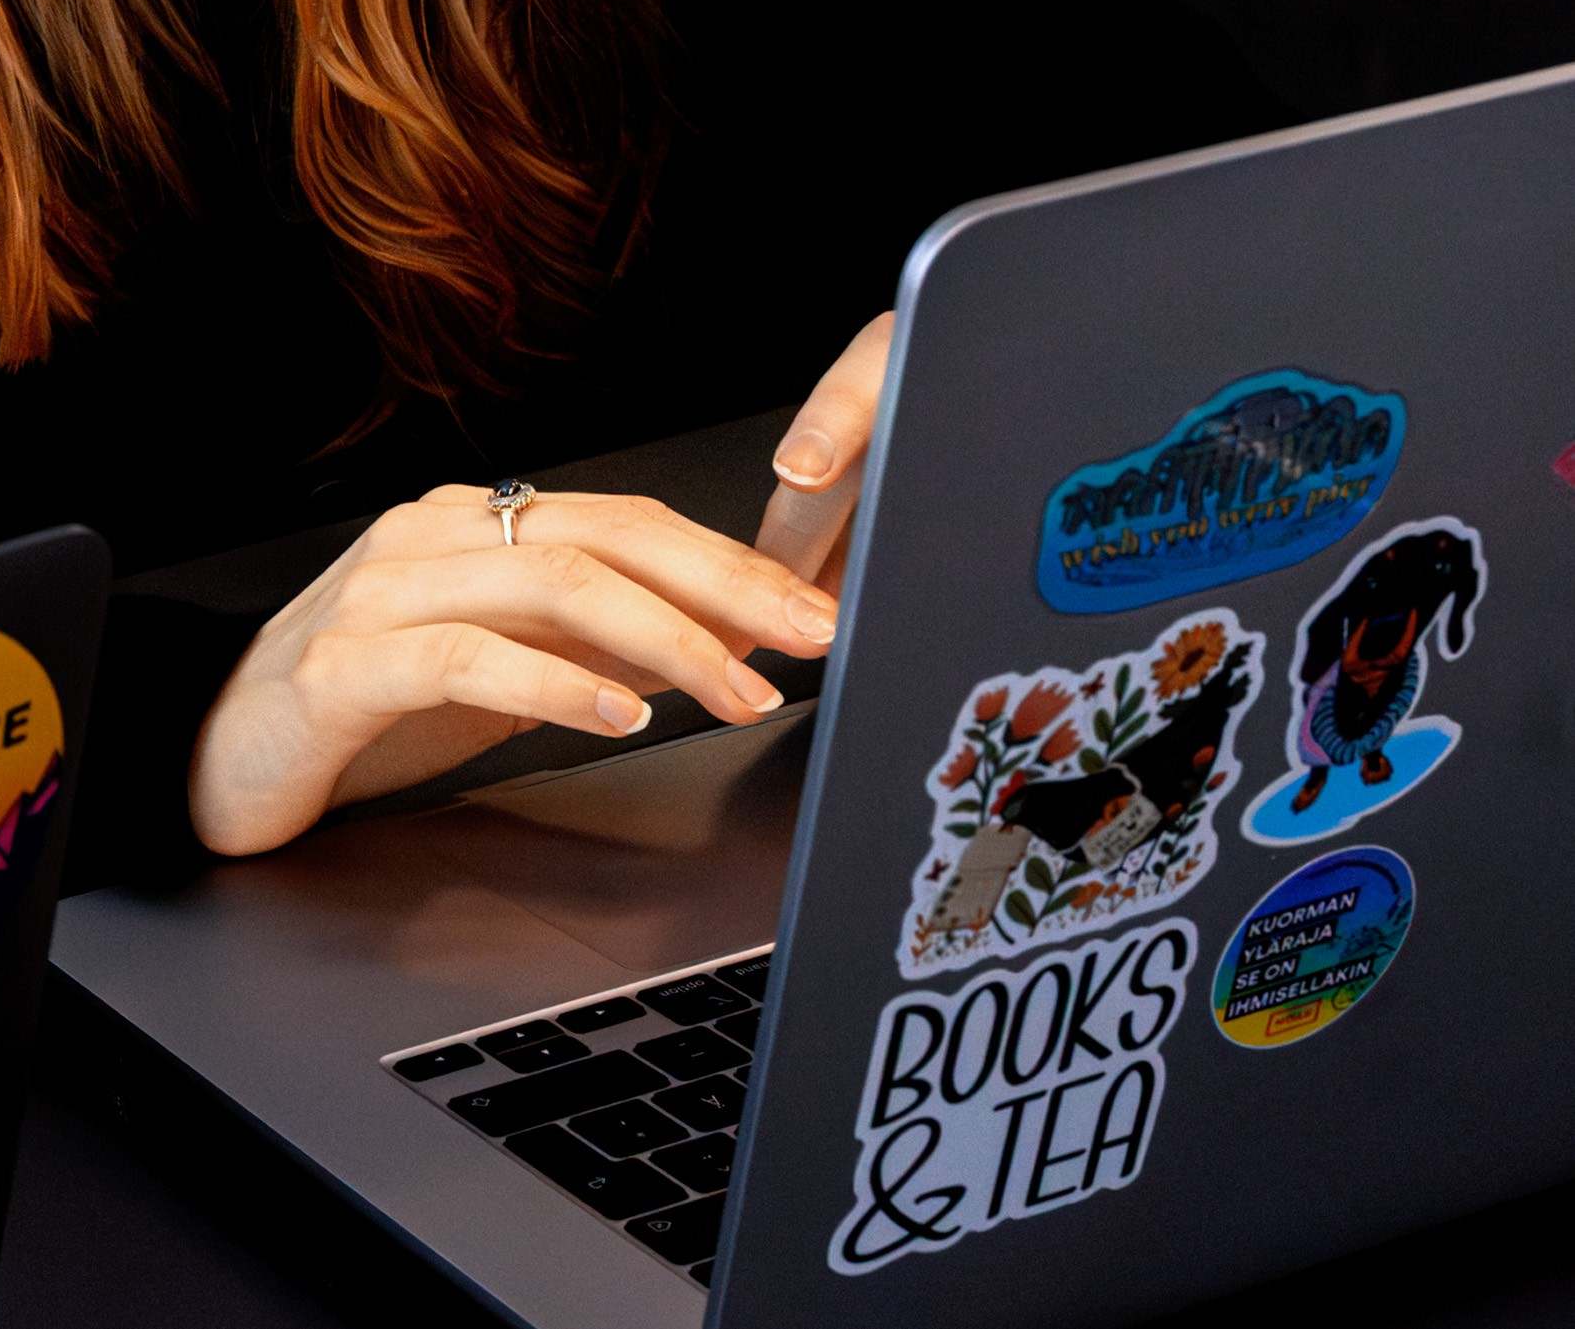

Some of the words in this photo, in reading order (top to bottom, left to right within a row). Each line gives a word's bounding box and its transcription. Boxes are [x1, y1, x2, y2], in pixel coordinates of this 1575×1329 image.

[1235, 970, 1259, 990] SE
[1263, 958, 1297, 981] ON
[1248, 891, 1356, 938] KUORMAN
[869, 928, 1188, 1129] BOOKS
[842, 1117, 966, 1264] &
[985, 1059, 1156, 1220] TEA
